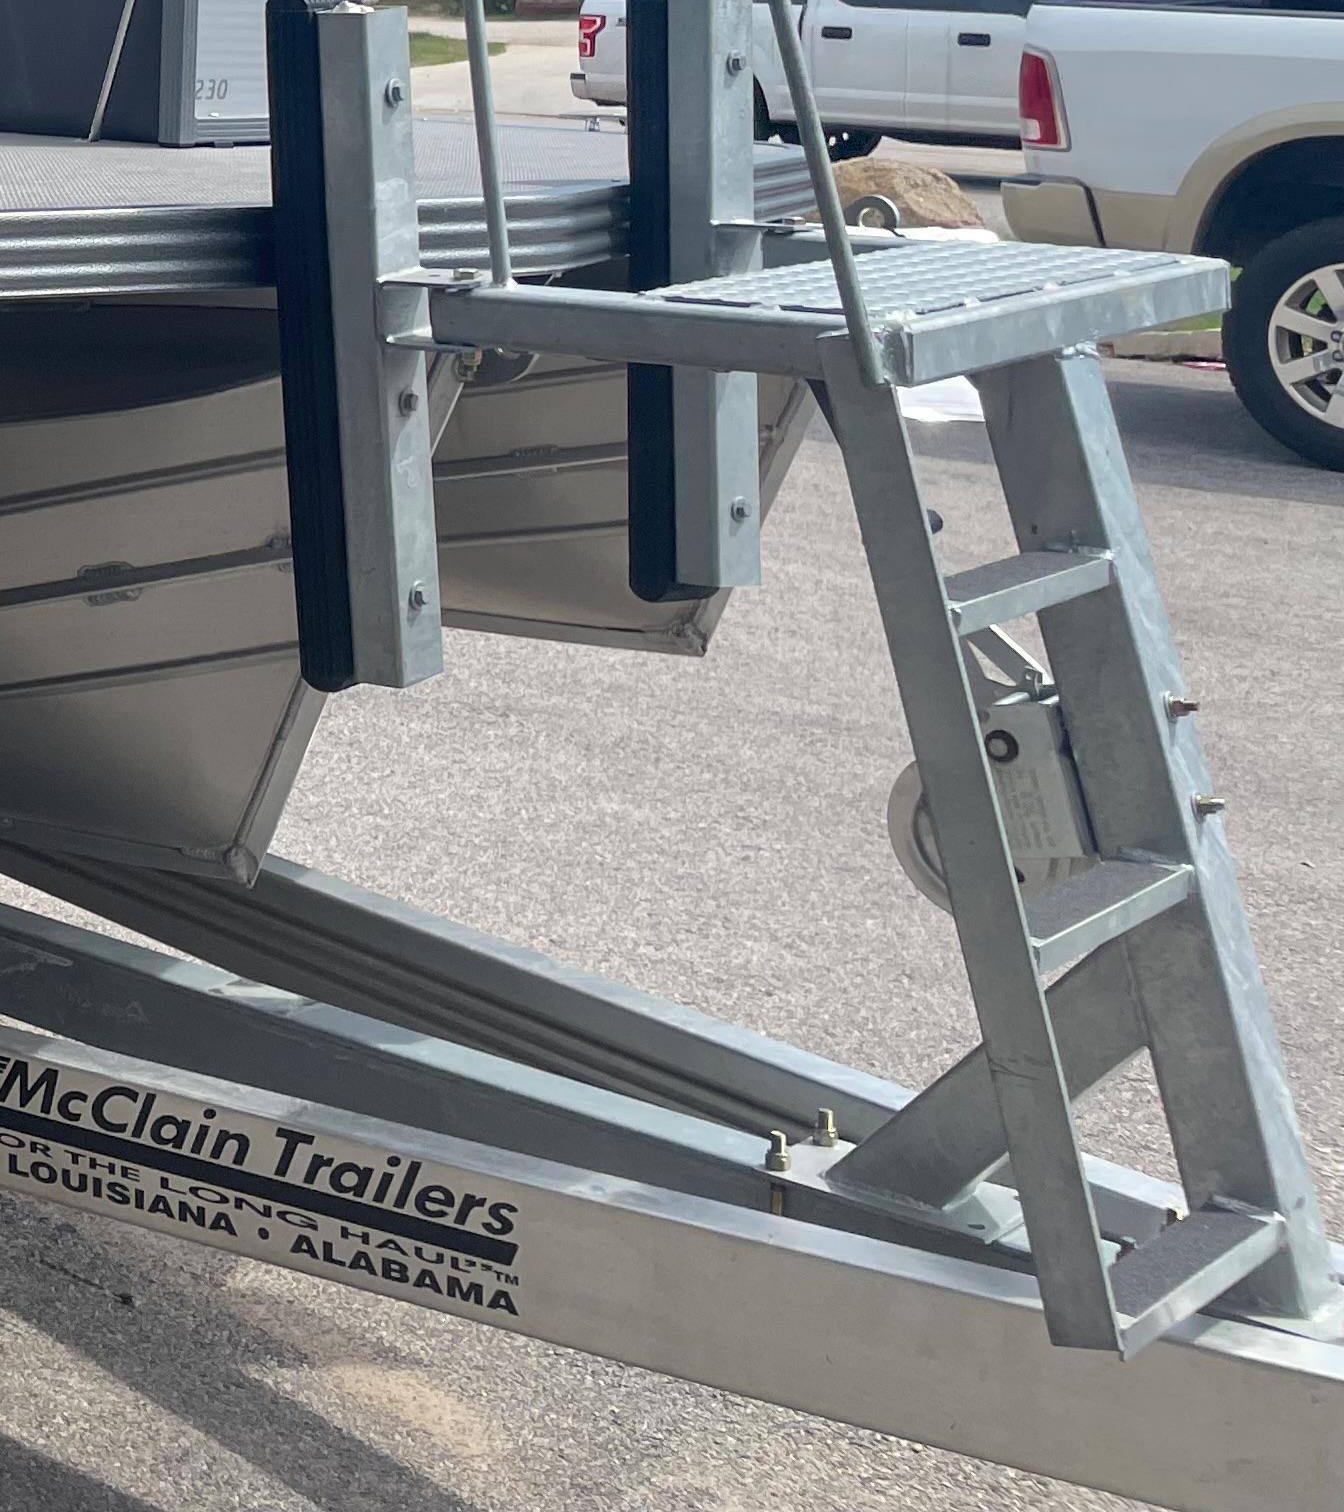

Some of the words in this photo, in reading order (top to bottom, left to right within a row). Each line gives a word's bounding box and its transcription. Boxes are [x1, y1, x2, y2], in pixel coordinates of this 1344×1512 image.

[194, 79, 228, 100] 230
[64, 1149, 141, 1182] THE
[159, 1175, 319, 1233] LONG
[273, 1126, 519, 1236] Trailers
[8, 1152, 239, 1237] LOUISIANA
[289, 1233, 520, 1317] ALABAMA
